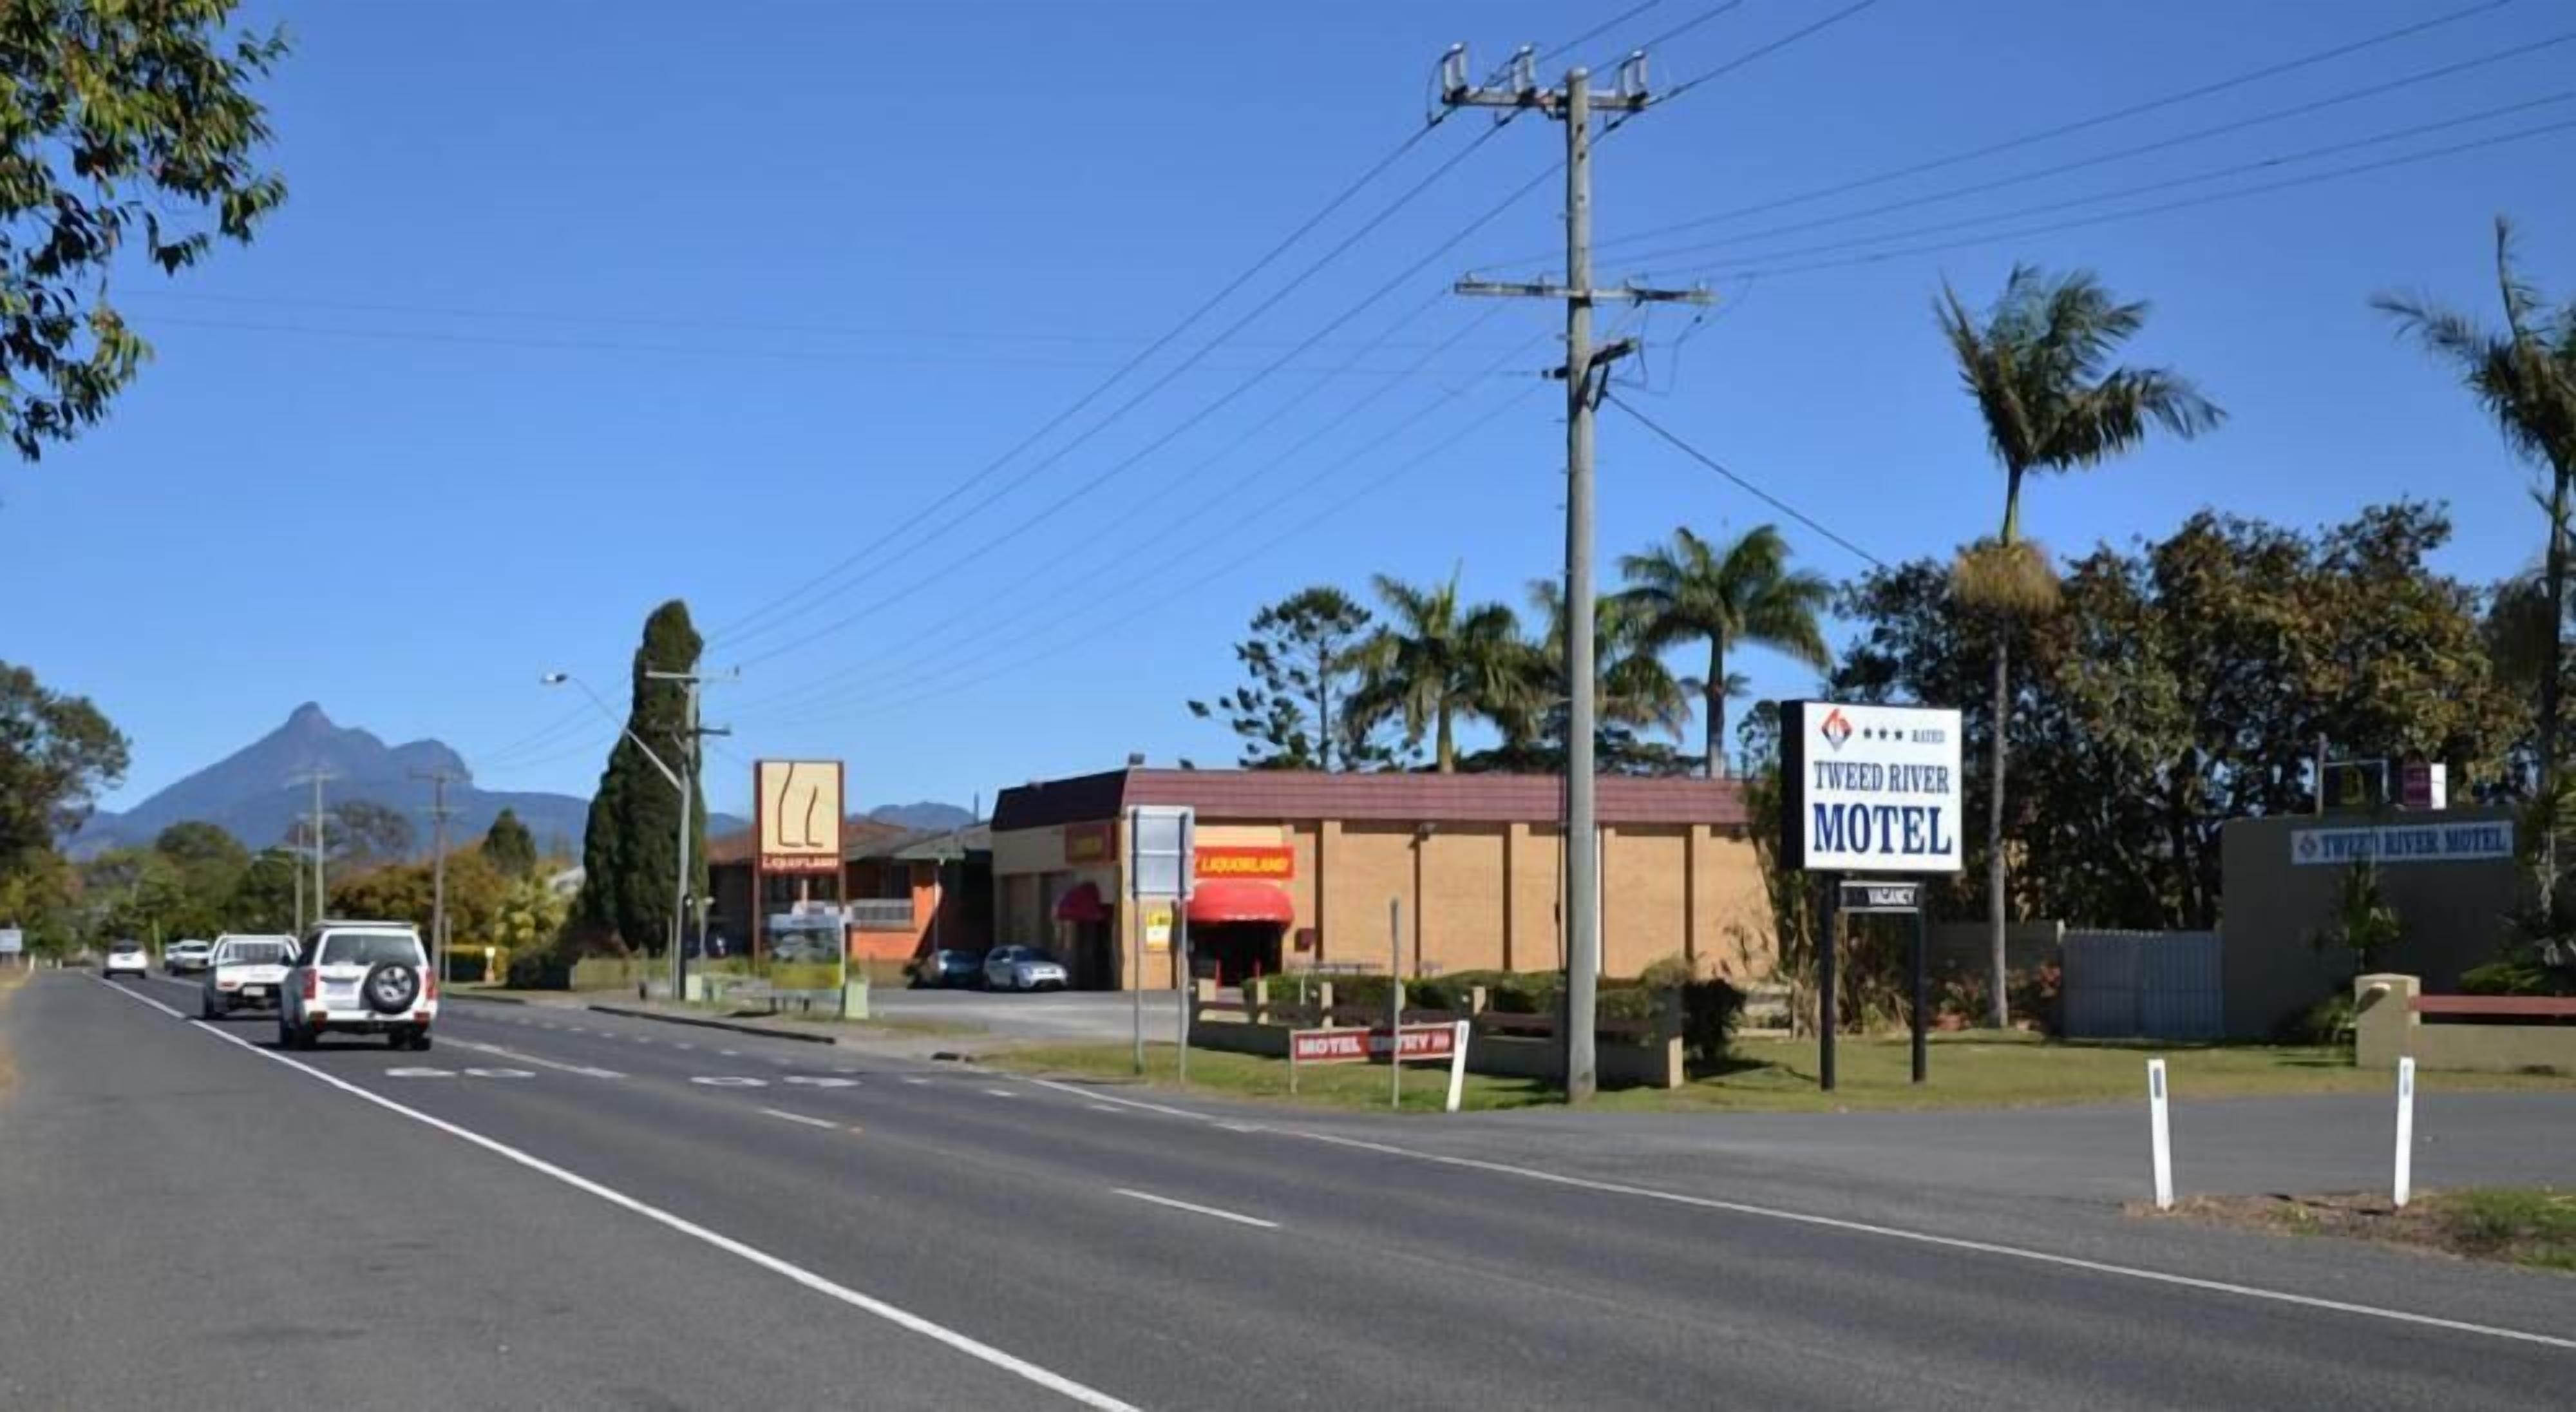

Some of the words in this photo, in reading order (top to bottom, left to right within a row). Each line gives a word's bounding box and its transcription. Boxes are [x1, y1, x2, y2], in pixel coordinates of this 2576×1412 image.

[1814, 760, 1883, 791] TWEED
[1889, 763, 1949, 794] RIVER
[1814, 803, 1952, 855] MOTEL
[2385, 830, 2439, 855] RIVER
[2445, 826, 2502, 853] MOTEL
[1298, 1036, 1361, 1054] MOTEL
